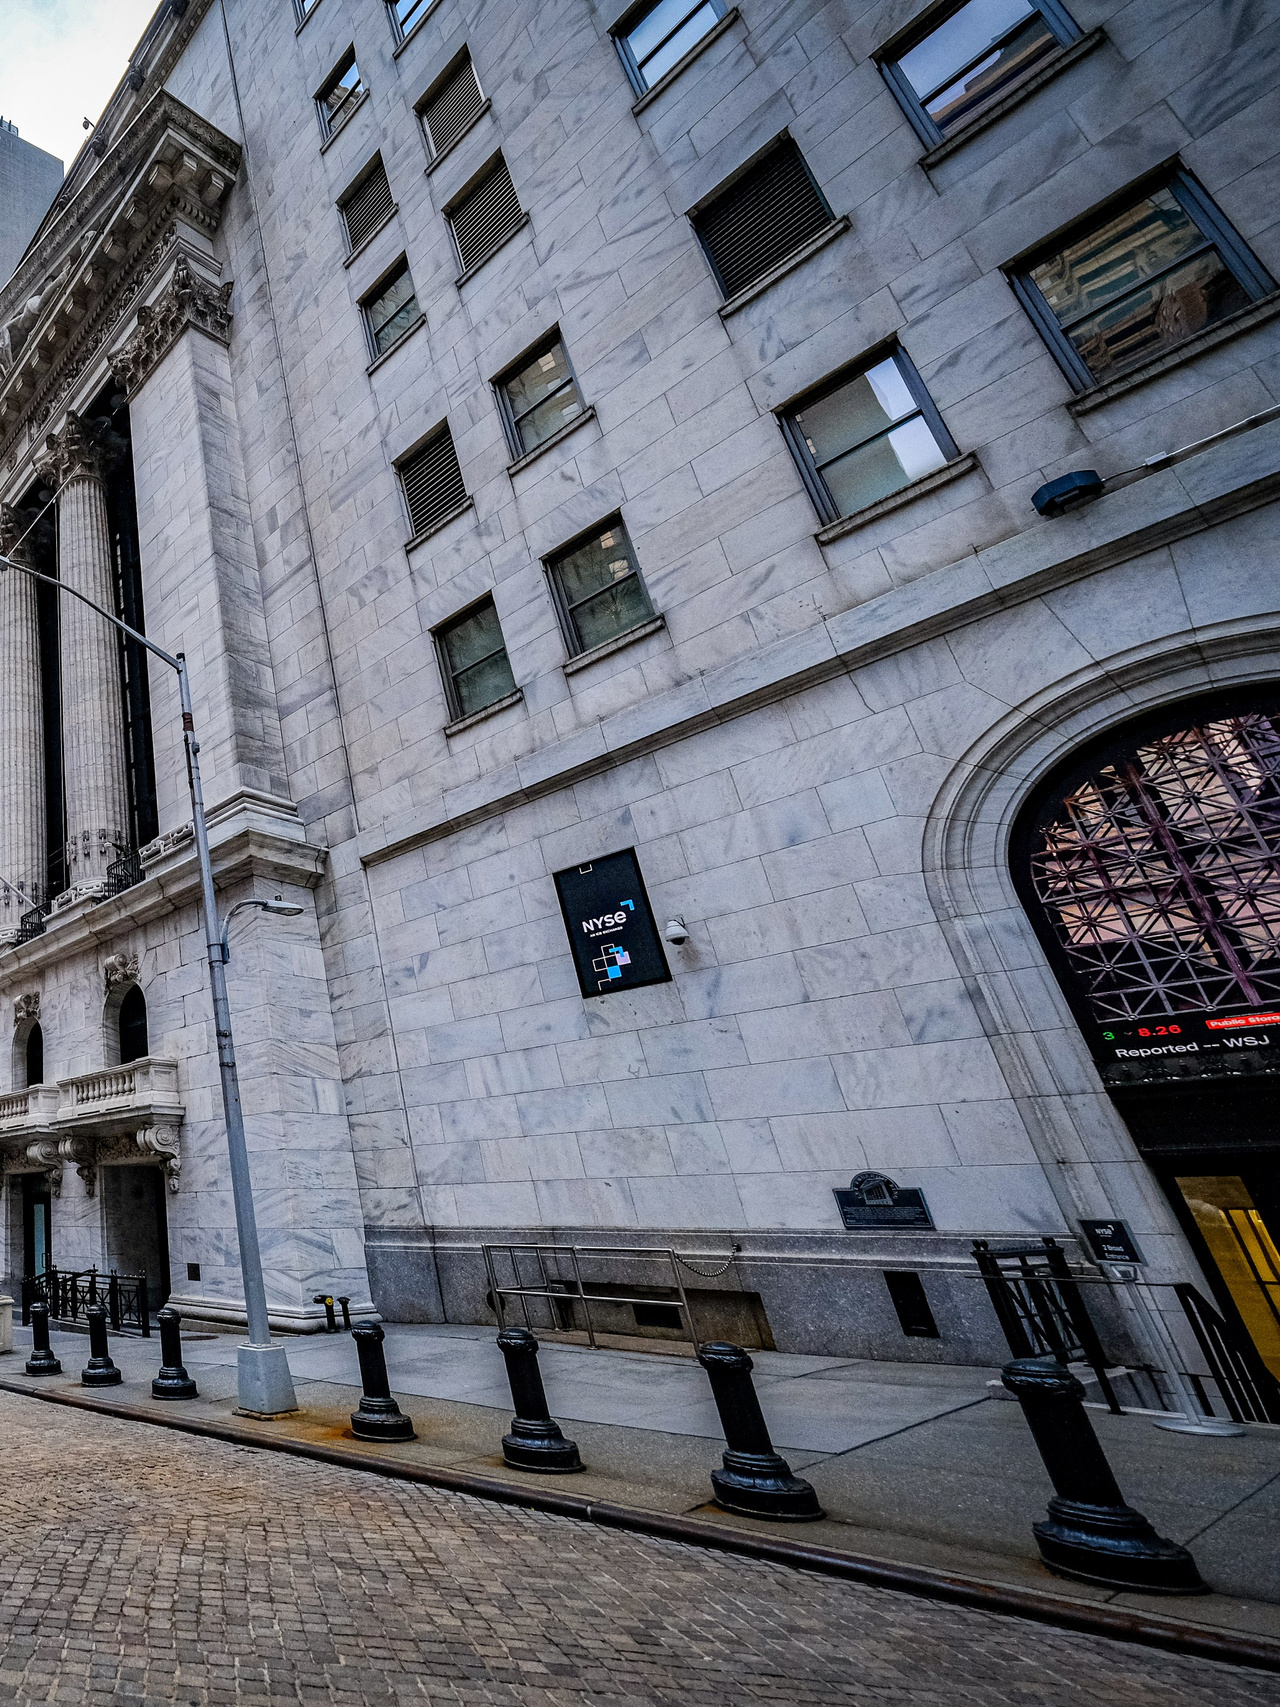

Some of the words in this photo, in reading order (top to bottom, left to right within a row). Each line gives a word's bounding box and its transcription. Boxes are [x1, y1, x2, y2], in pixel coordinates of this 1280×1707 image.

[1210, 1018, 1246, 1027] Public
[1102, 1031, 1115, 1040] 3
[1137, 1024, 1182, 1037] 8.26
[1115, 1041, 1200, 1058] Reported
[1222, 1034, 1270, 1048] WSJ
